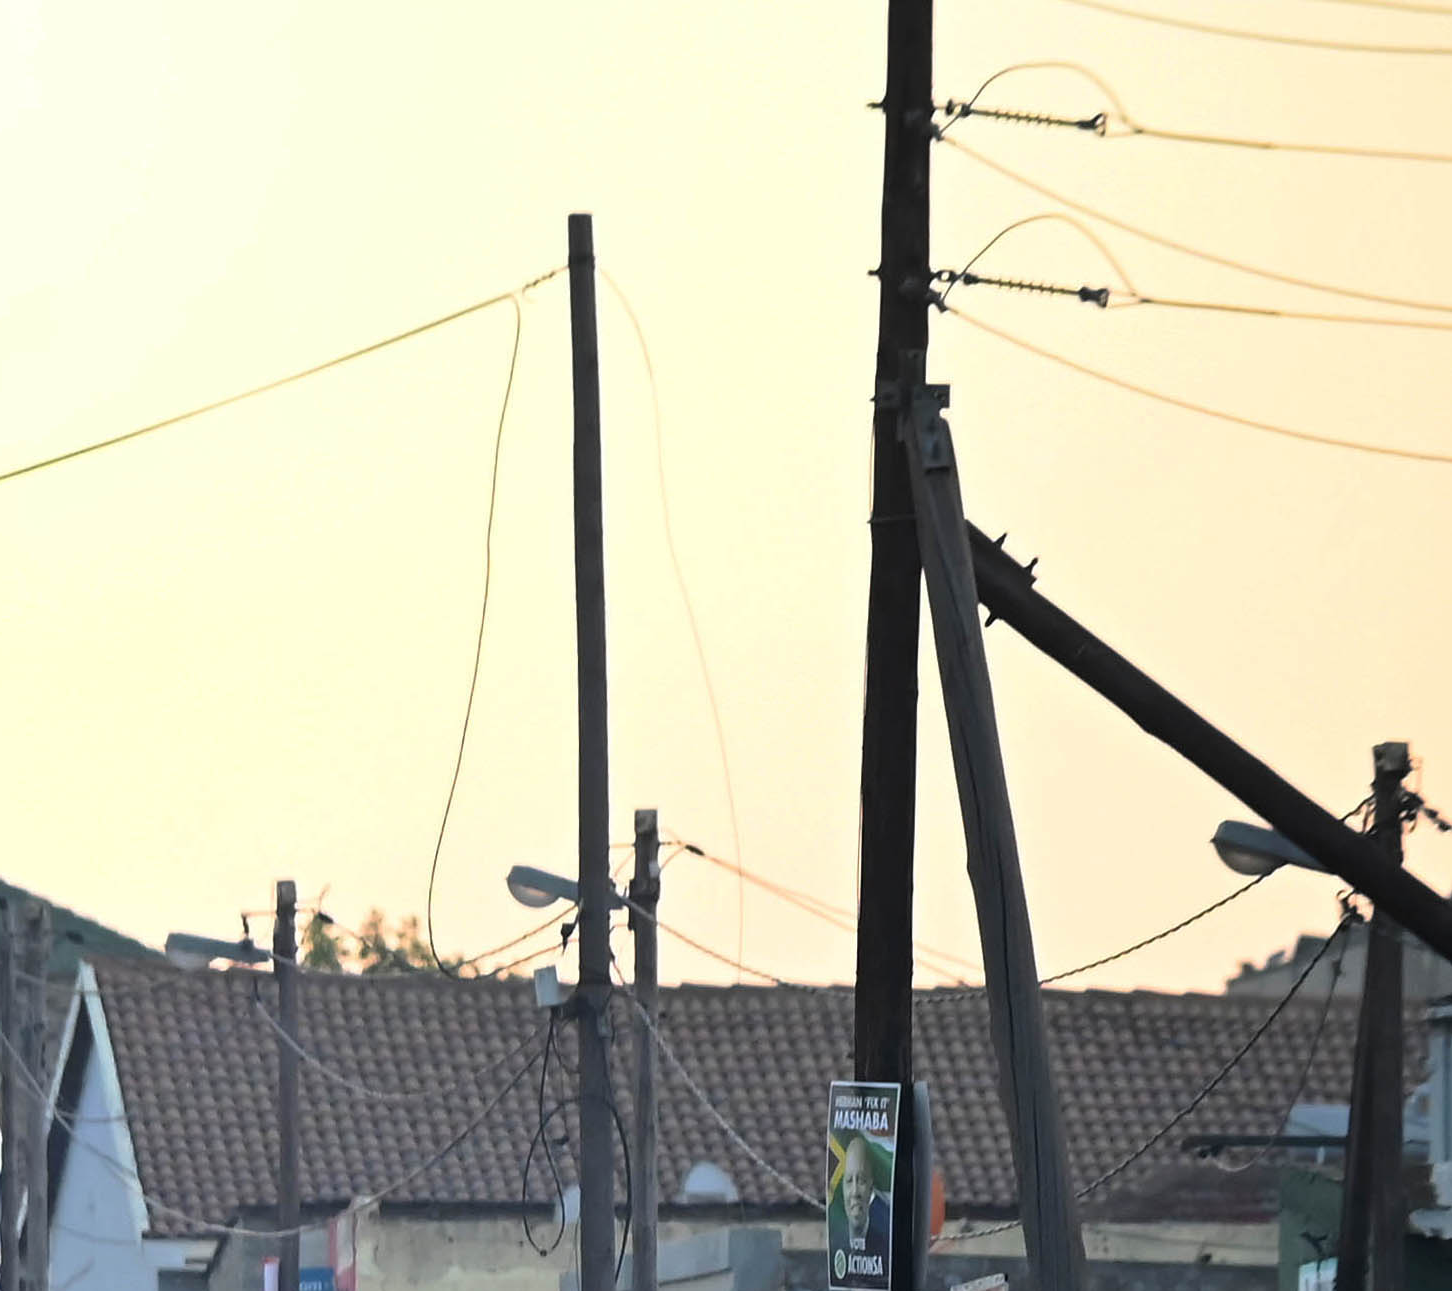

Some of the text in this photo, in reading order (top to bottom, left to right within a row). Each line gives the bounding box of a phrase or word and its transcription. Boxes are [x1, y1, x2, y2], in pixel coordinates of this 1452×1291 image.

[834, 1110, 889, 1130] MASHABA
[849, 1238, 866, 1250] VOTE
[848, 1253, 883, 1275] ACTIONSA
